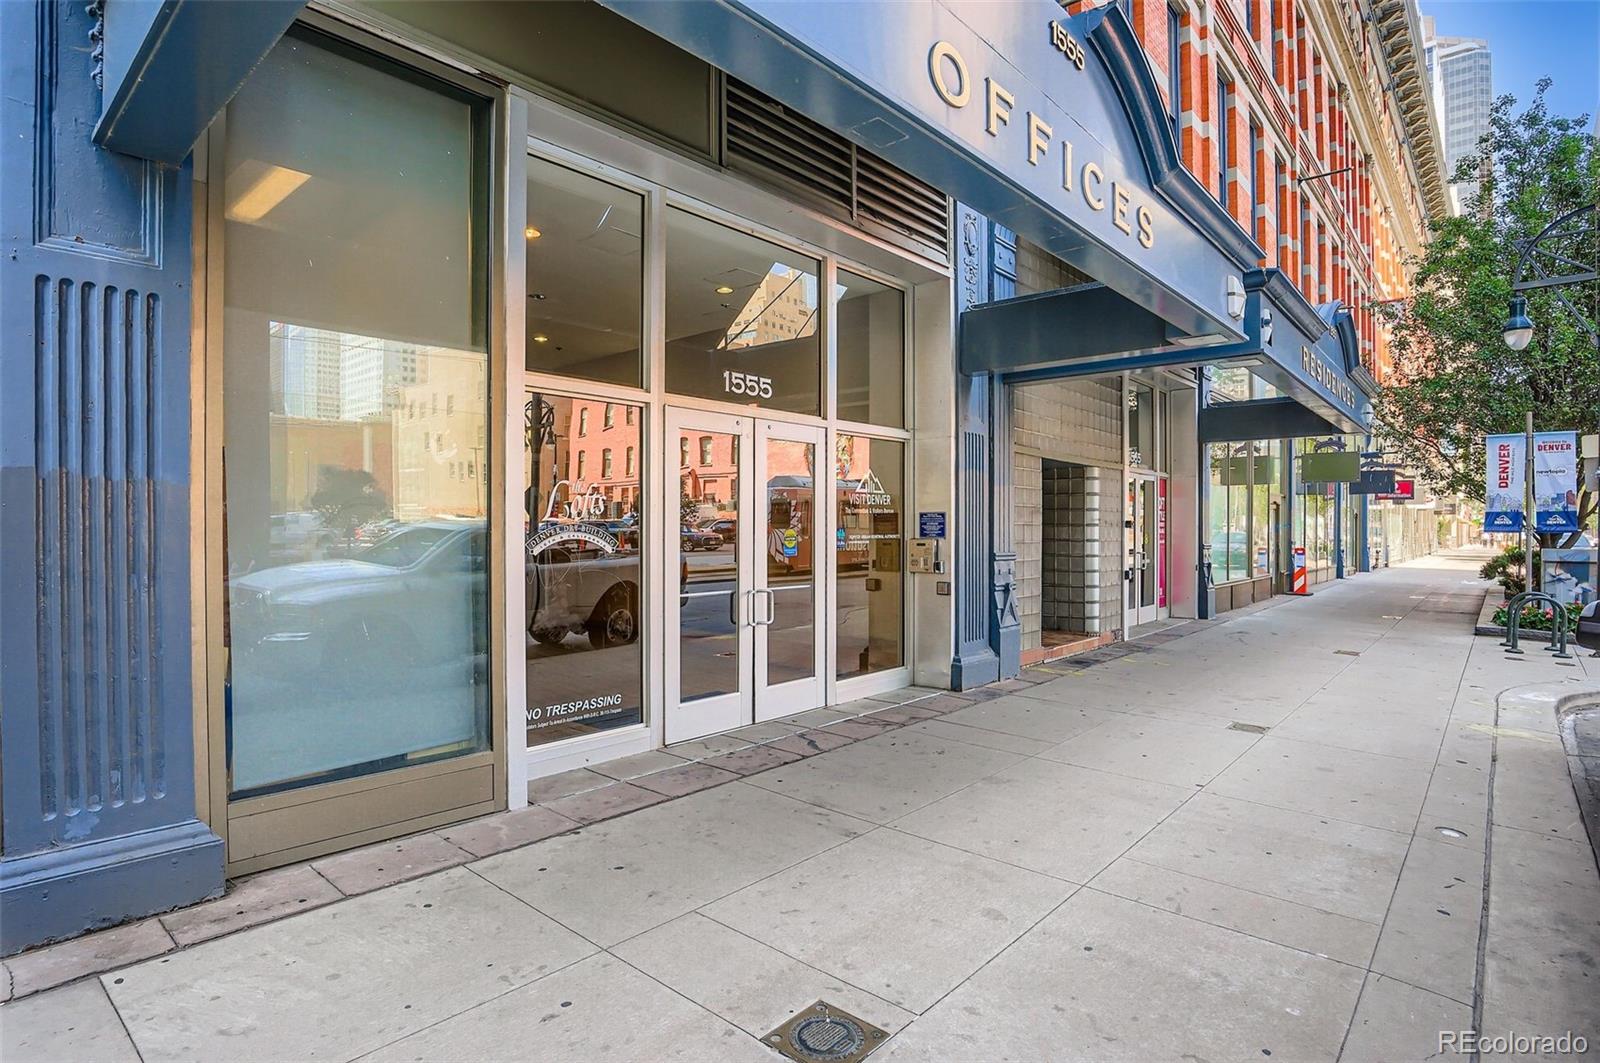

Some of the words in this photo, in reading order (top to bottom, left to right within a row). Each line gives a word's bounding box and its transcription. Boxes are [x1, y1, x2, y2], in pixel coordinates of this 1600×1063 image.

[1048, 20, 1085, 71] 1555
[928, 40, 1156, 250] OFFICES
[723, 370, 773, 399] 1555
[1302, 345, 1355, 409] RESIDENCES
[1537, 443, 1571, 451] DENVER
[1498, 444, 1511, 489] DENVER
[541, 480, 606, 522] Lofts
[848, 494, 867, 505] VISIT
[867, 495, 891, 505] DENVER
[530, 528, 561, 547] DENVER
[581, 526, 615, 547] BUILDING
[526, 708, 541, 721] NO
[545, 694, 622, 717] TRESPASSING
